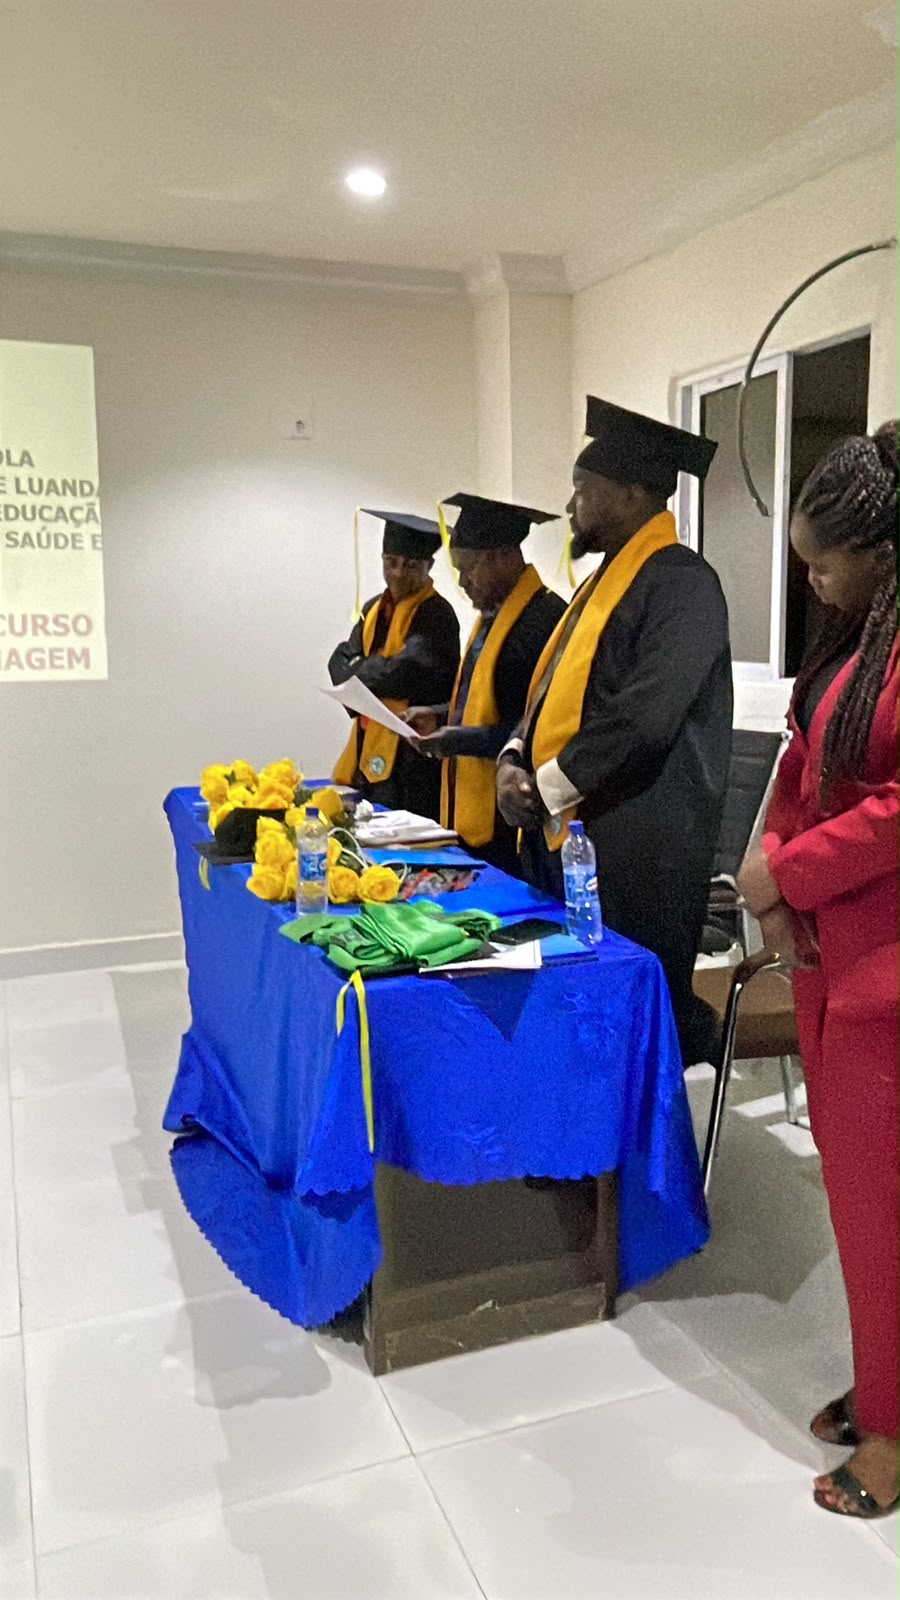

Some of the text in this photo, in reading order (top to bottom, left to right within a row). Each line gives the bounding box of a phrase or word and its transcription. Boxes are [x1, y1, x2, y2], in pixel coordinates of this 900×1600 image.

[0, 448, 35, 468] LA
[15, 476, 99, 497] LUAND
[0, 501, 99, 528] DUCAÇÃ
[5, 525, 84, 550] SAÚDE
[0, 646, 90, 671] AGEM
